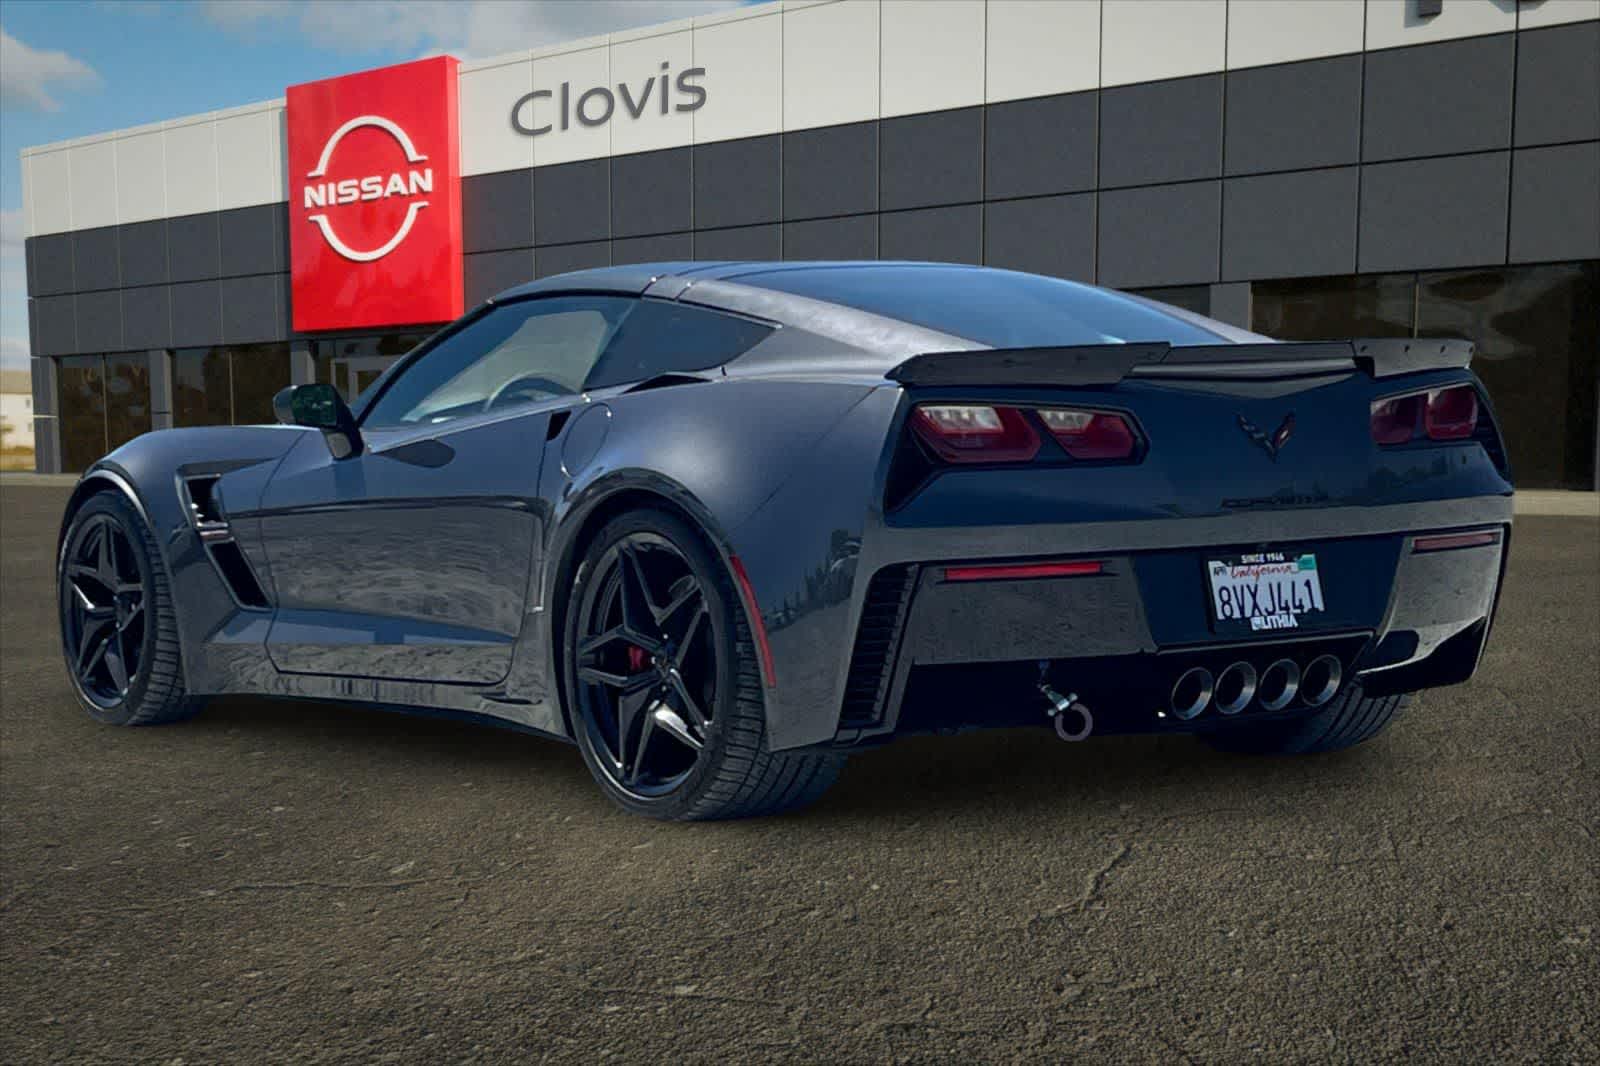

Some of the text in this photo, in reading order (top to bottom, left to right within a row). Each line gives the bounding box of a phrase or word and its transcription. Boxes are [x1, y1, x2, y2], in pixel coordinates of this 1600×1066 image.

[511, 61, 707, 136] Clovis
[303, 168, 433, 209] NISSAN
[1218, 579, 1316, 619] 8VXJ441
